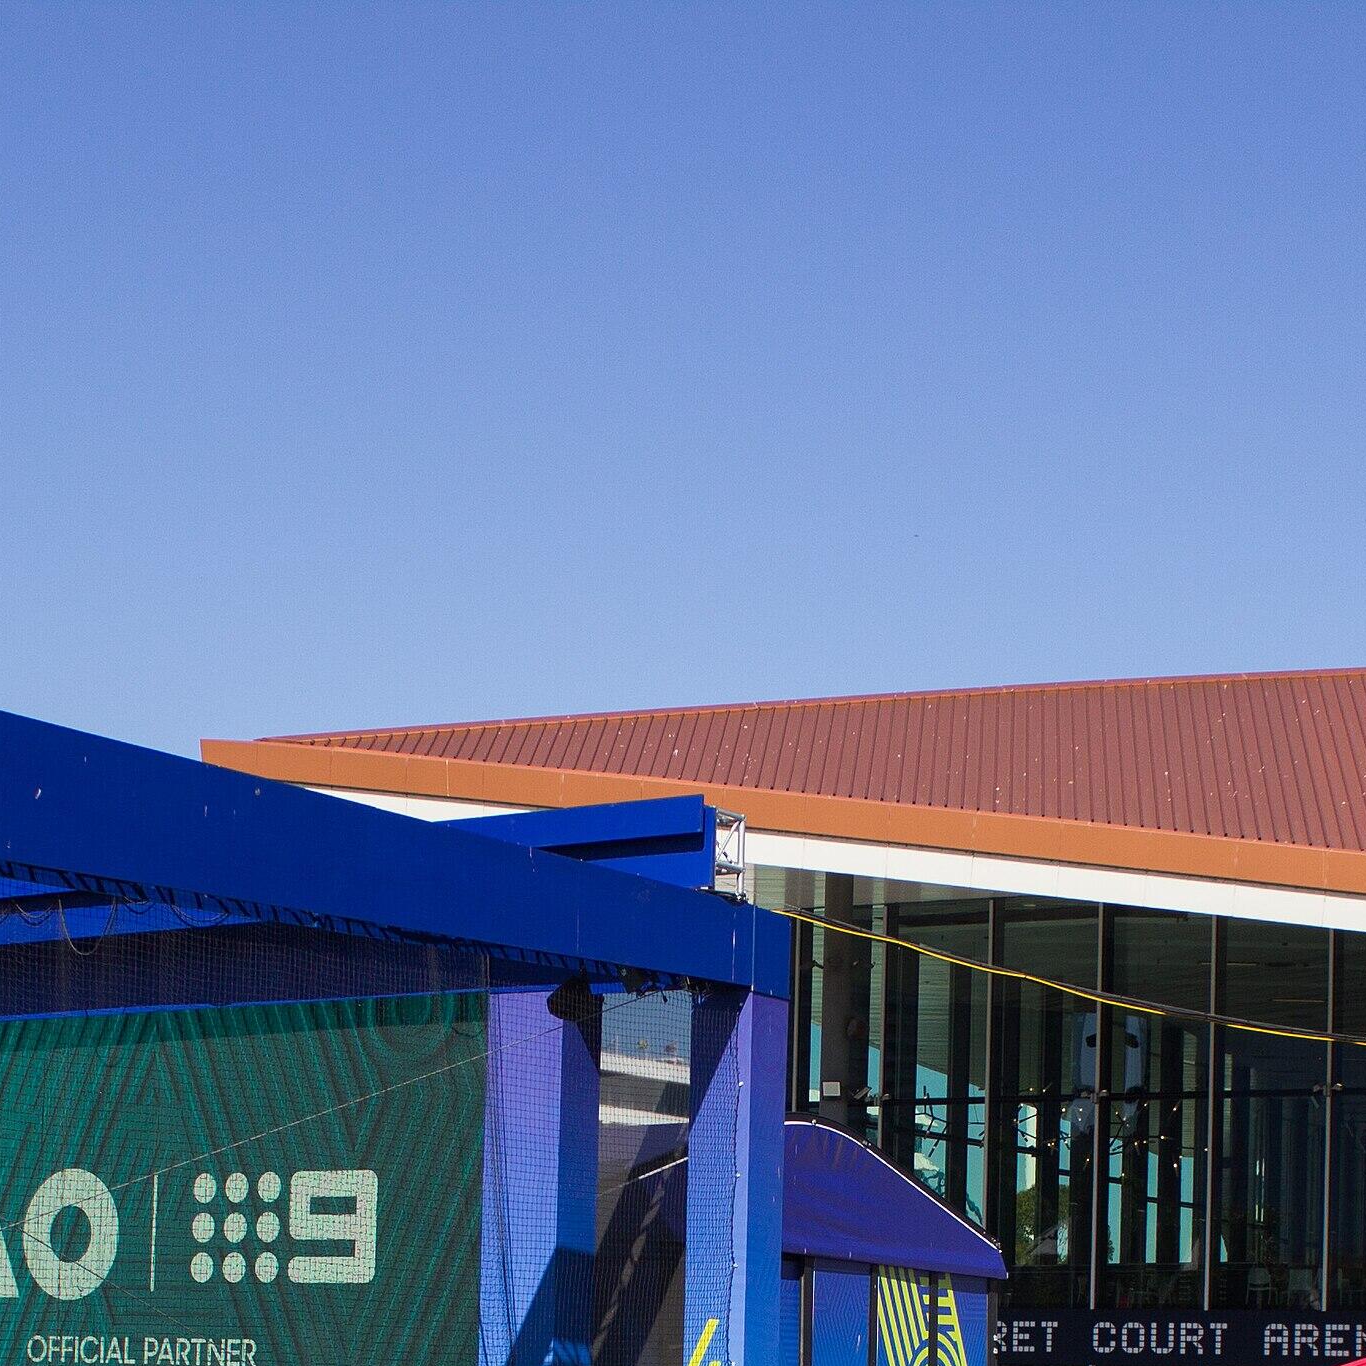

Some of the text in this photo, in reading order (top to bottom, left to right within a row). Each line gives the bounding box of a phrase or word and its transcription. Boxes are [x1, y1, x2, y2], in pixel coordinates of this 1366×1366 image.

[27, 1335, 257, 1366] OFFICIAL PARTNER
[1092, 1321, 1229, 1356] COURT
